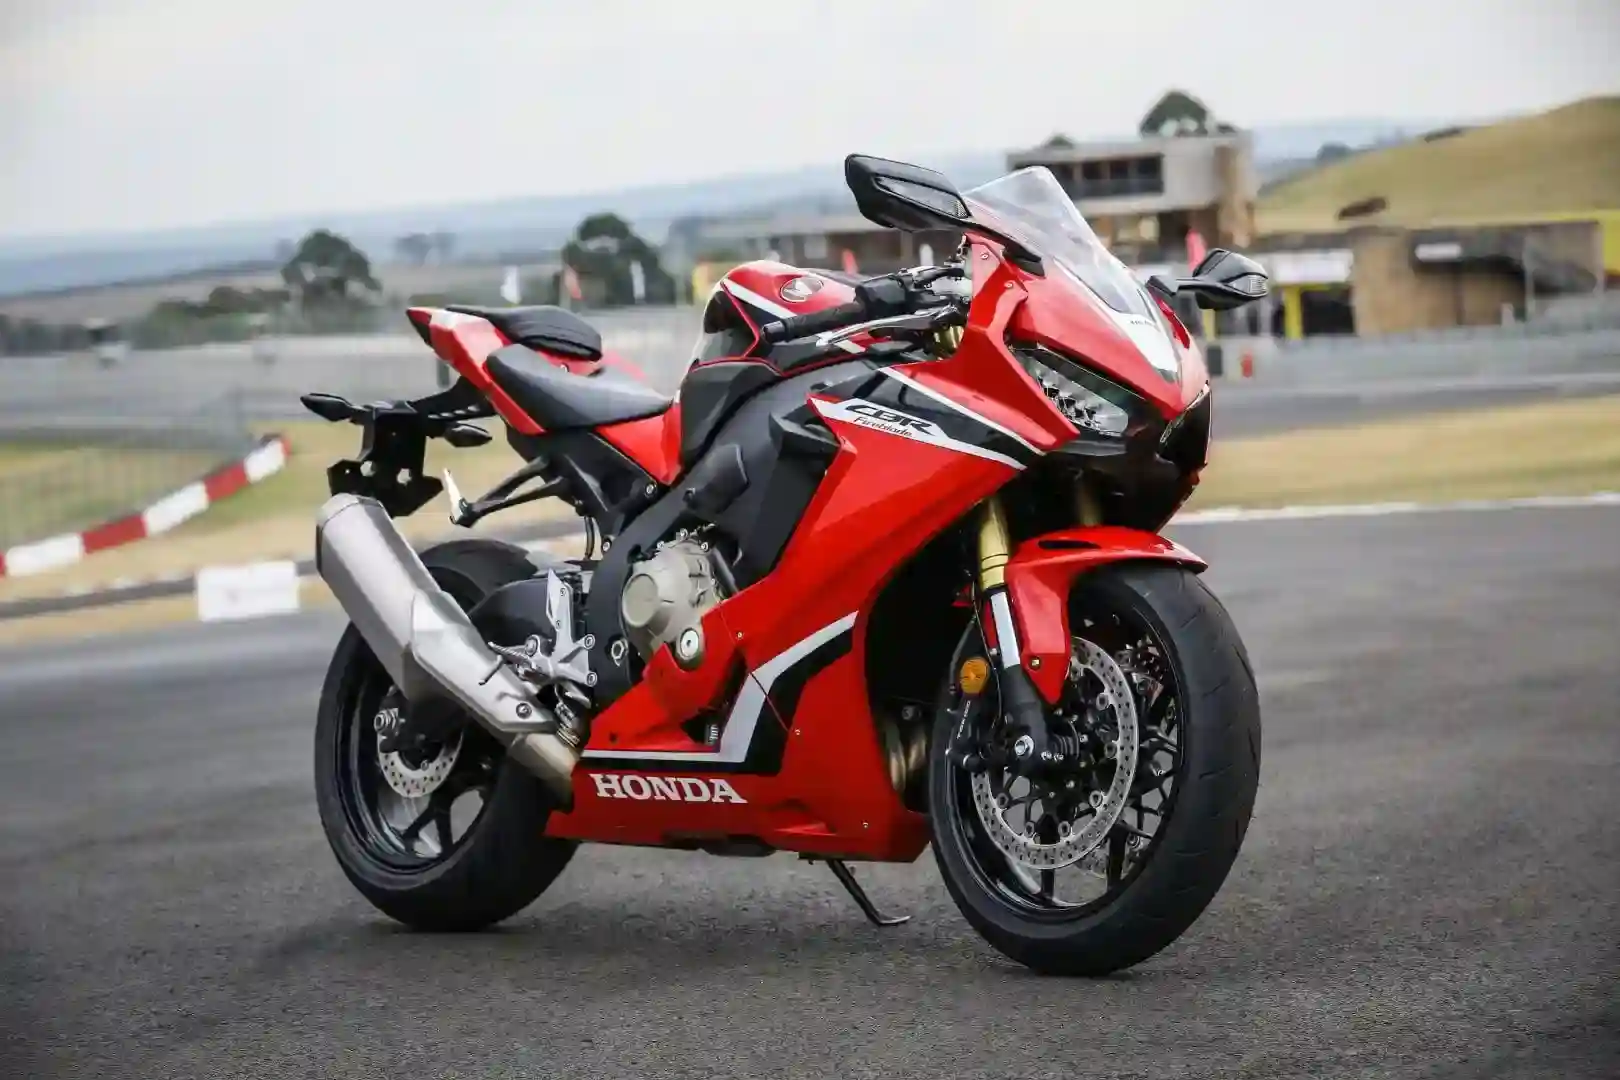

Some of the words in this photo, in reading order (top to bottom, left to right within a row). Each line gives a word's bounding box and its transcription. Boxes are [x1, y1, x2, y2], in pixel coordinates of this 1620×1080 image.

[845, 405, 935, 436] CBR
[854, 416, 914, 437] Fireblade
[588, 773, 748, 804] HONDA
